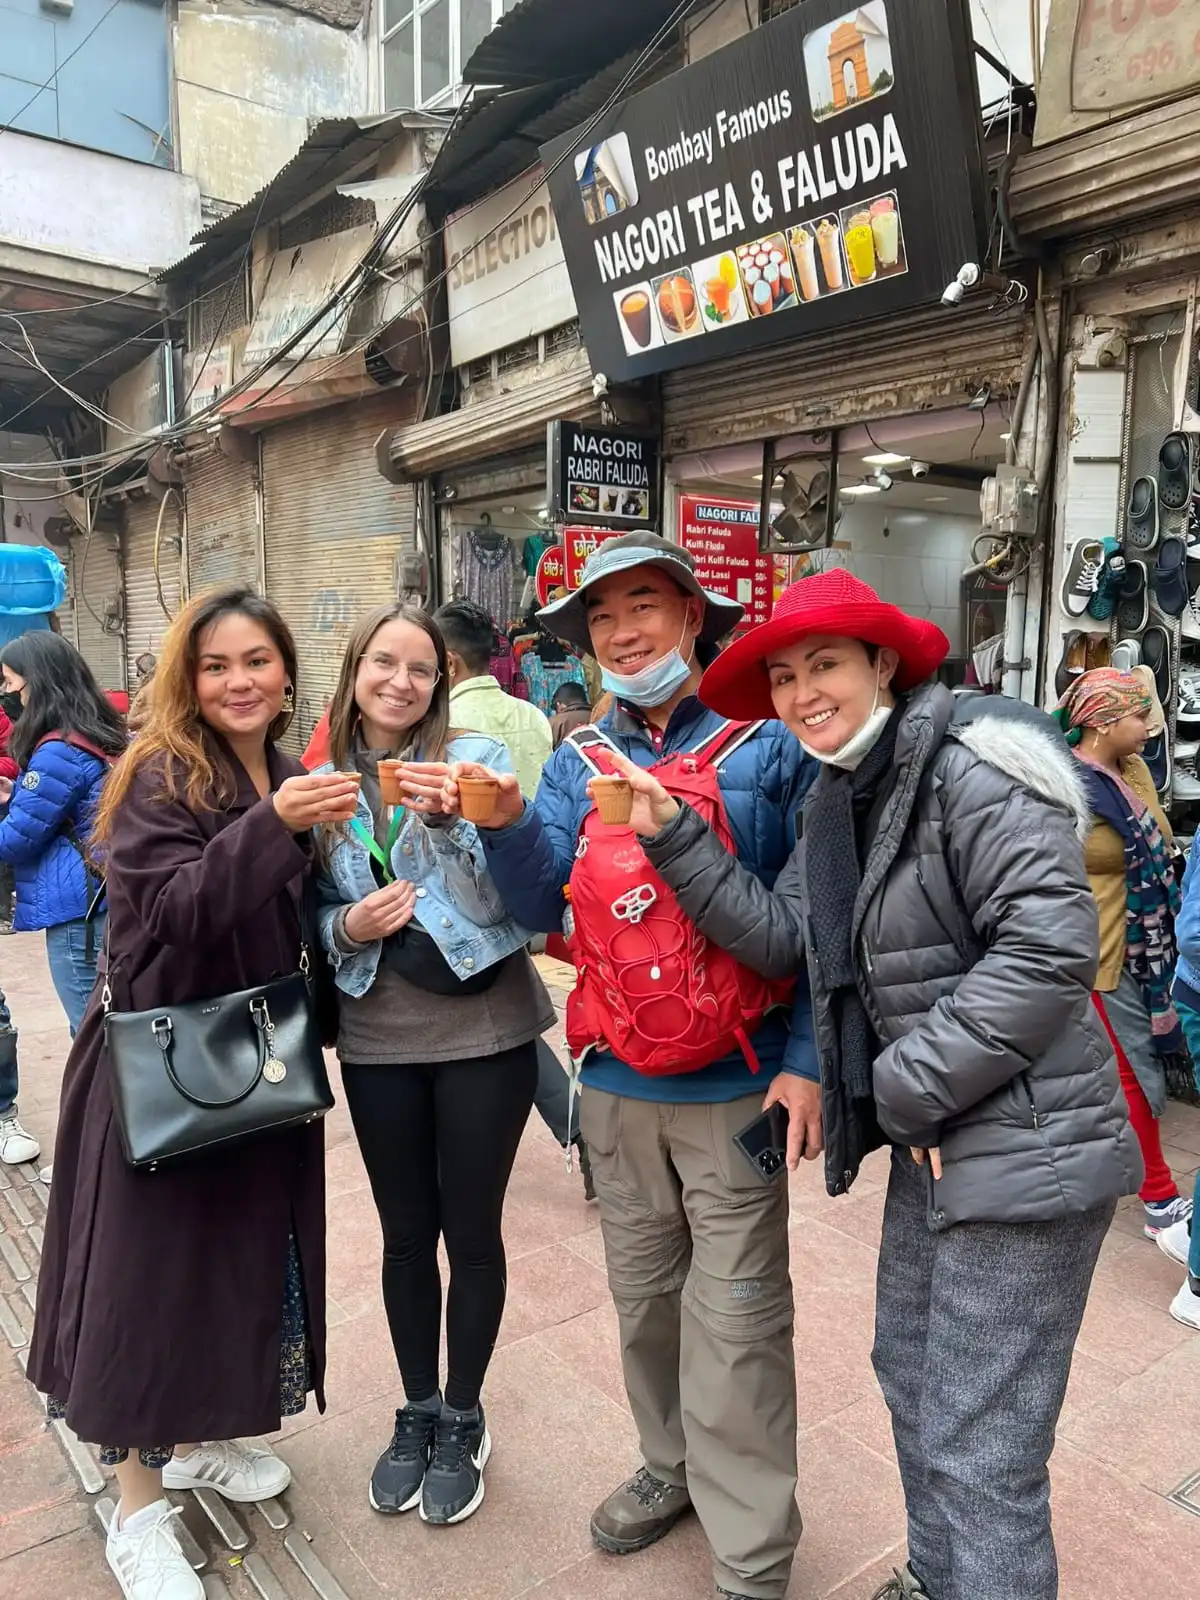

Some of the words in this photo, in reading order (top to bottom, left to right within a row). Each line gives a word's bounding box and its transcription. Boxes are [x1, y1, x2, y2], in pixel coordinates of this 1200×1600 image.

[645, 129, 713, 181] Bombay
[716, 88, 792, 149] Famous
[593, 204, 686, 283] NAGORI
[687, 182, 746, 242] TEA
[751, 170, 773, 224] &
[777, 113, 907, 213] FALUDA
[573, 433, 642, 460] NAGORI
[568, 456, 603, 481] RABRI
[606, 460, 649, 487] FALUDA
[698, 507, 738, 521] NAGORI
[686, 524, 706, 534] Rabri
[708, 526, 732, 537] Faluda
[686, 539, 704, 549] Kulfi
[707, 555, 724, 565] Kulfi
[726, 557, 749, 567] Faluda
[711, 570, 730, 579] Lassi
